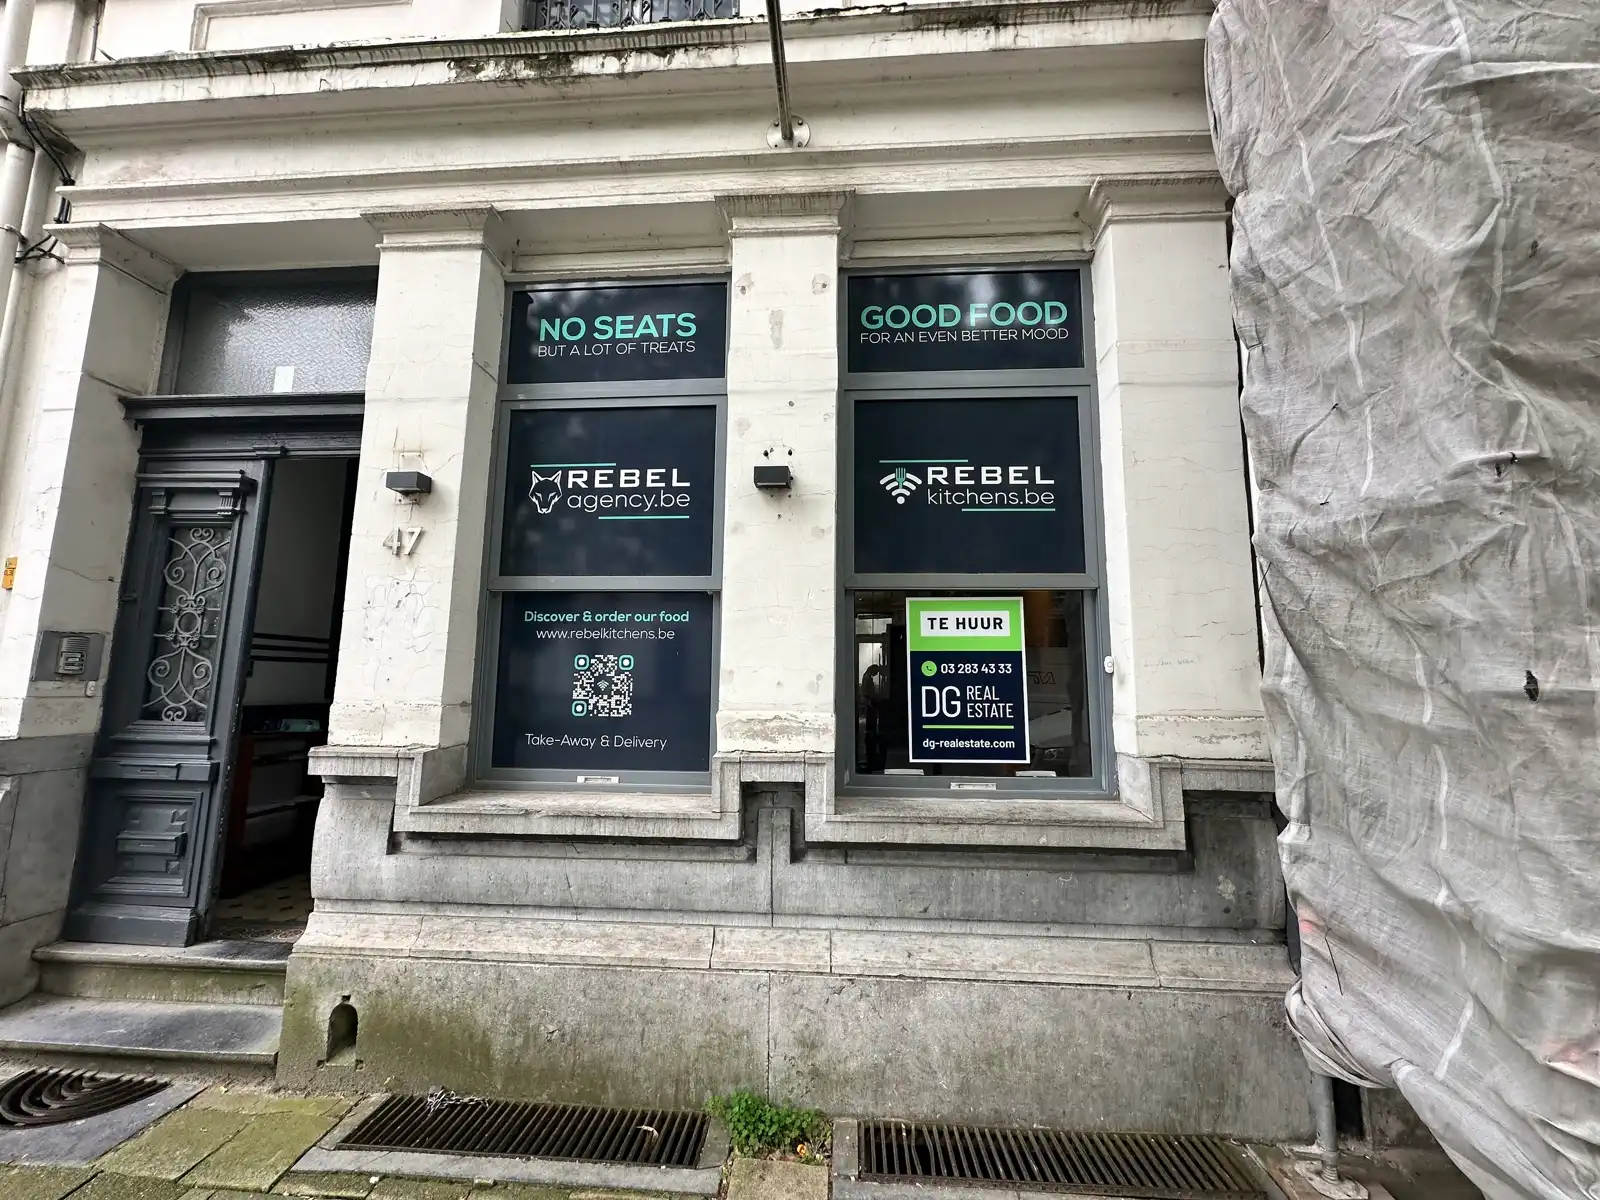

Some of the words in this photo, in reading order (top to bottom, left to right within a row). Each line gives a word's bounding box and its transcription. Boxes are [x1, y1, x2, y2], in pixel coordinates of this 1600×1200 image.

[861, 304, 961, 329] GOOD
[970, 301, 1068, 326] FOOD
[540, 317, 586, 341] NO
[593, 313, 697, 339] SEATS
[861, 333, 890, 343] FOR
[894, 332, 914, 342] AN
[919, 331, 956, 342] EVEN
[962, 329, 1017, 342] BETTER
[1021, 327, 1069, 340] MOOD
[537, 344, 567, 357] BUT
[569, 344, 581, 356] A
[585, 344, 612, 355] LOT
[616, 343, 636, 354] OF
[641, 341, 695, 353] TREATS
[567, 468, 690, 489] REBEL
[927, 465, 1054, 485] REBEL
[567, 489, 690, 513] agency.be
[927, 488, 1054, 505] kitchens.be
[383, 527, 423, 556] 47
[524, 610, 580, 623] Discover
[582, 610, 592, 622] &
[594, 610, 632, 622] order
[634, 613, 657, 622] our
[658, 610, 689, 622] food
[926, 617, 948, 630] TE
[955, 617, 1002, 630] HUUR
[536, 627, 674, 640] www.rebelkitchens.be
[940, 664, 954, 674] 03
[957, 663, 978, 674] 283
[980, 663, 995, 674] 43
[997, 663, 1012, 674] 33
[966, 685, 999, 701] REAL
[921, 685, 960, 718] DG
[966, 702, 1013, 718] ESTATE
[524, 733, 596, 750] Take-Away
[600, 734, 609, 748] &
[613, 735, 667, 751] Delivery
[922, 738, 1015, 750] dg-realestate.com
